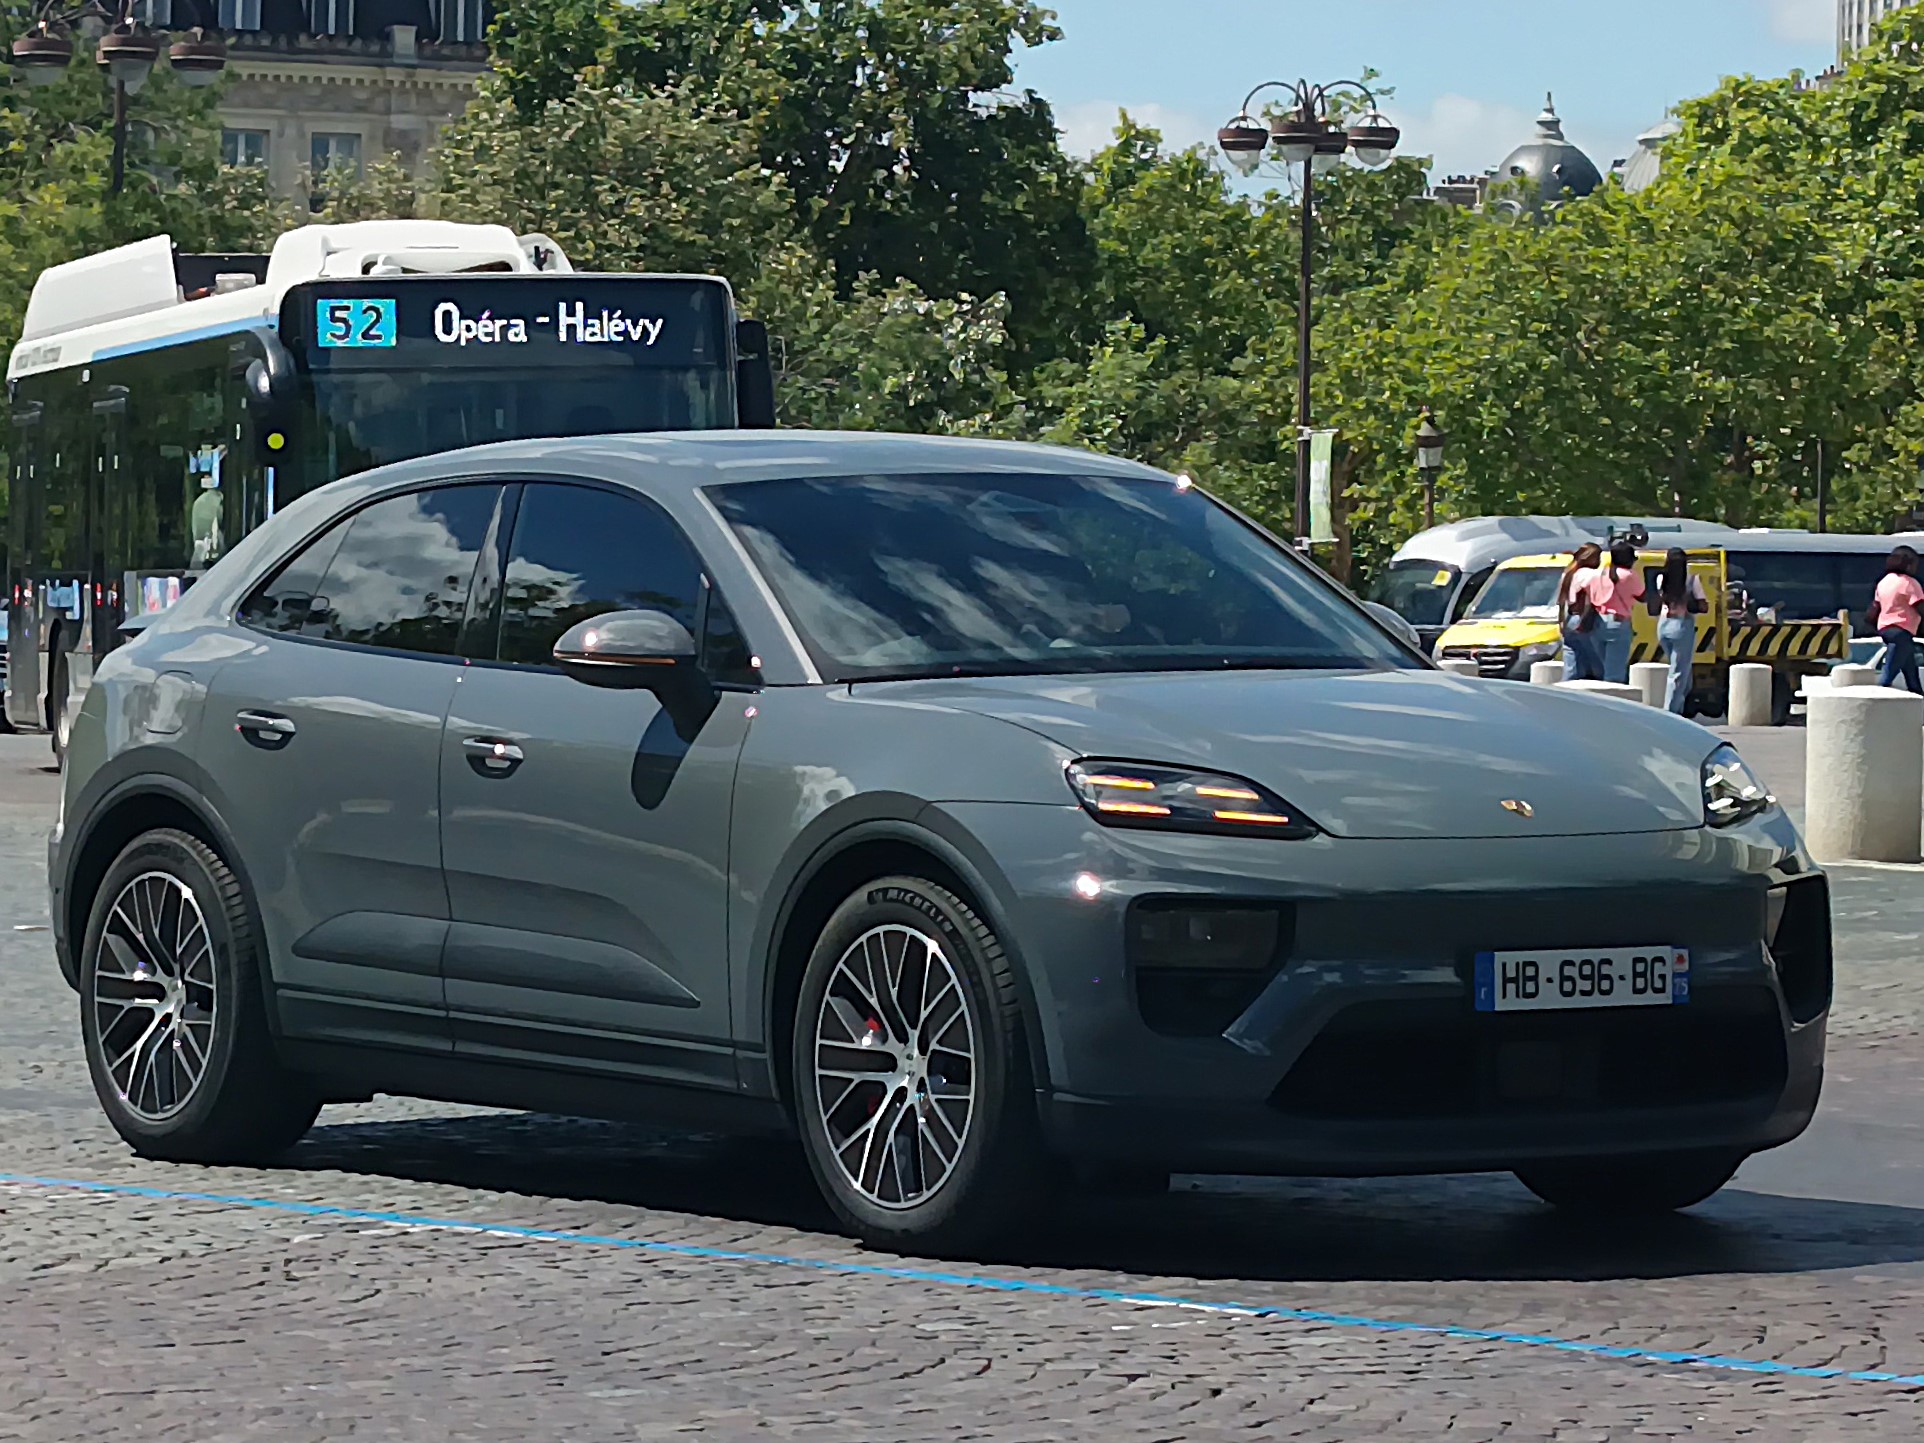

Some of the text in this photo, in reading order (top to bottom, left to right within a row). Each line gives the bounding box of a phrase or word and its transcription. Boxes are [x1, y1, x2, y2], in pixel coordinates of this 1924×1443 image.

[329, 305, 383, 341] 52
[434, 302, 527, 346] Opéra
[558, 301, 663, 345] Halévy
[1501, 956, 1667, 1000] HB-696-BG
